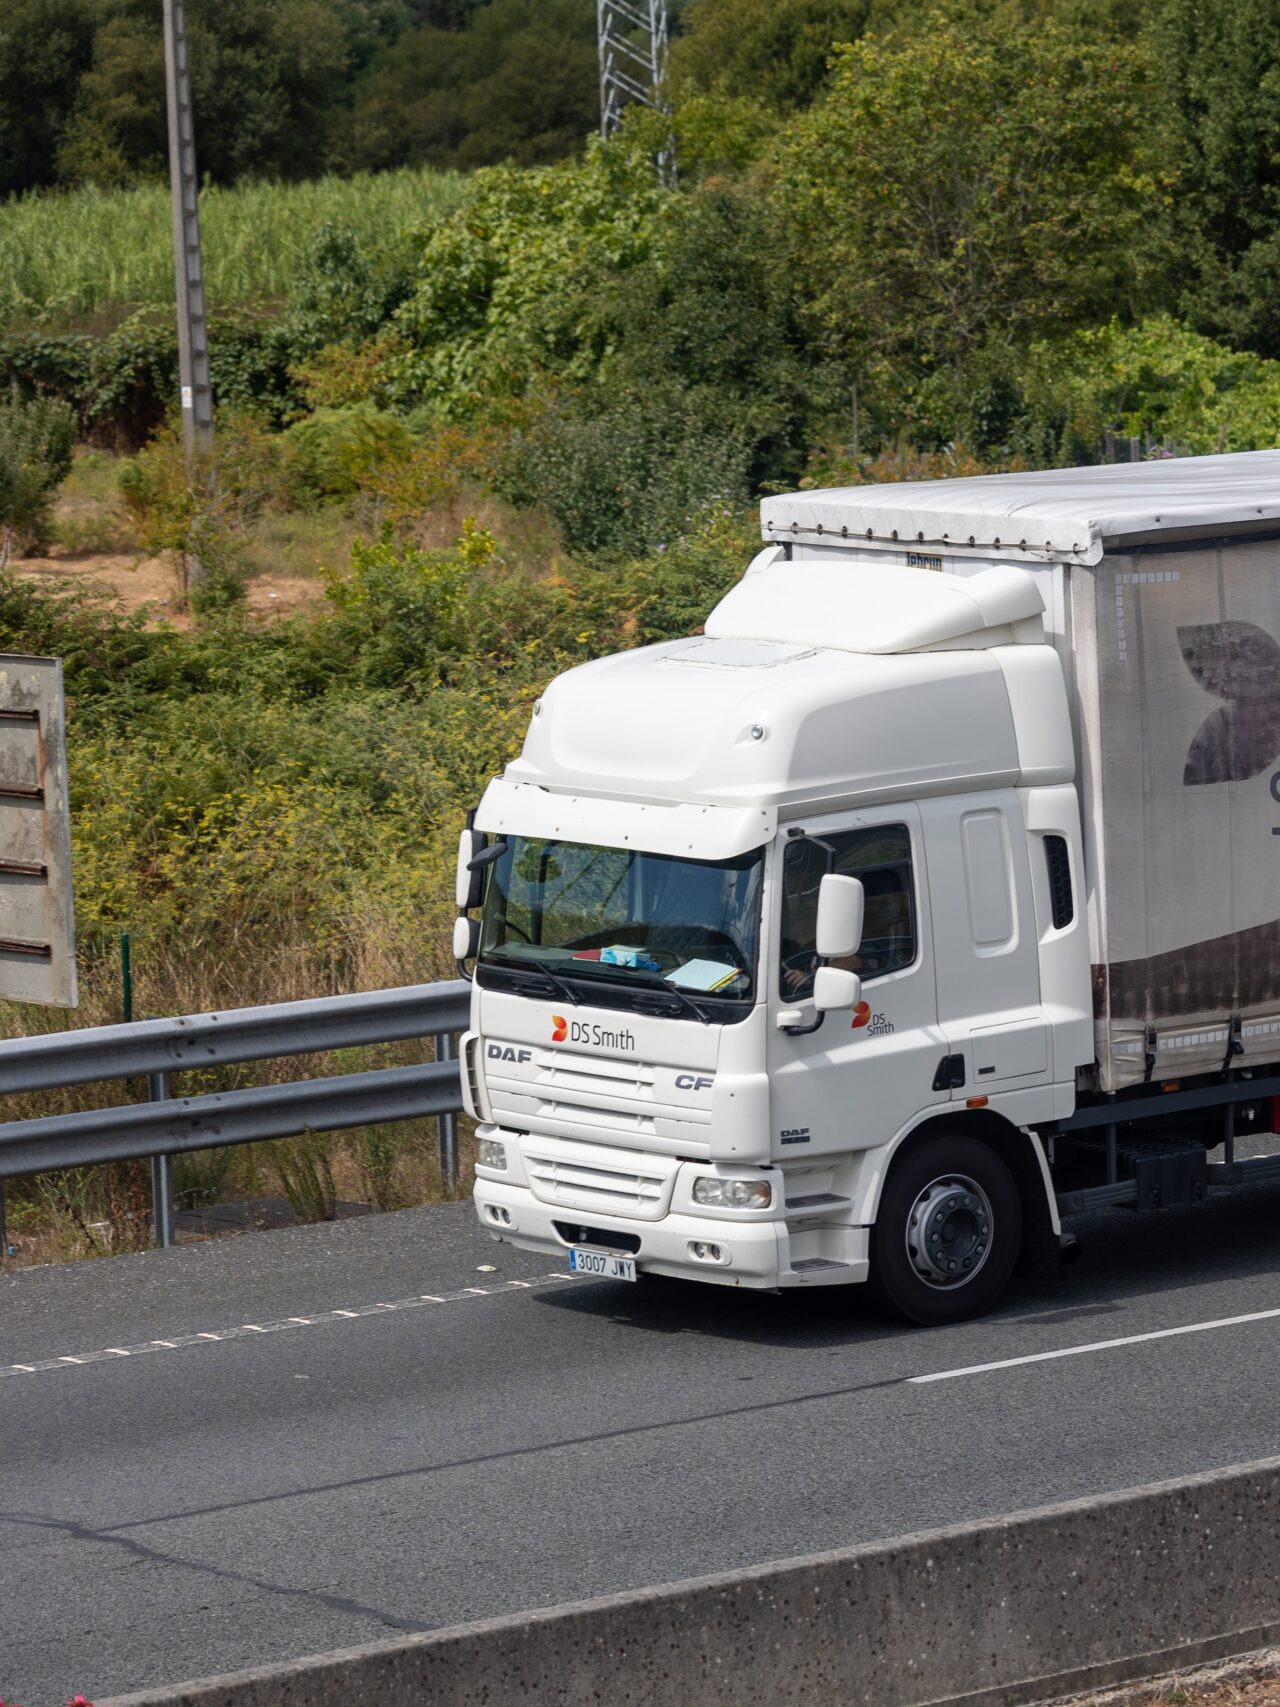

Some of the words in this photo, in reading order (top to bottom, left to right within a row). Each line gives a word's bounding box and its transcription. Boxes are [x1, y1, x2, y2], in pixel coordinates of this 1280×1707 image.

[872, 1013, 886, 1026] DS
[571, 1022, 590, 1044] DS
[593, 1025, 635, 1051] Smith
[867, 1021, 895, 1037] Smith
[488, 1044, 532, 1063] DAF
[674, 1074, 714, 1091] CF
[780, 1128, 810, 1137] DAF
[578, 1253, 607, 1273] 3007
[611, 1260, 632, 1278] JWY
